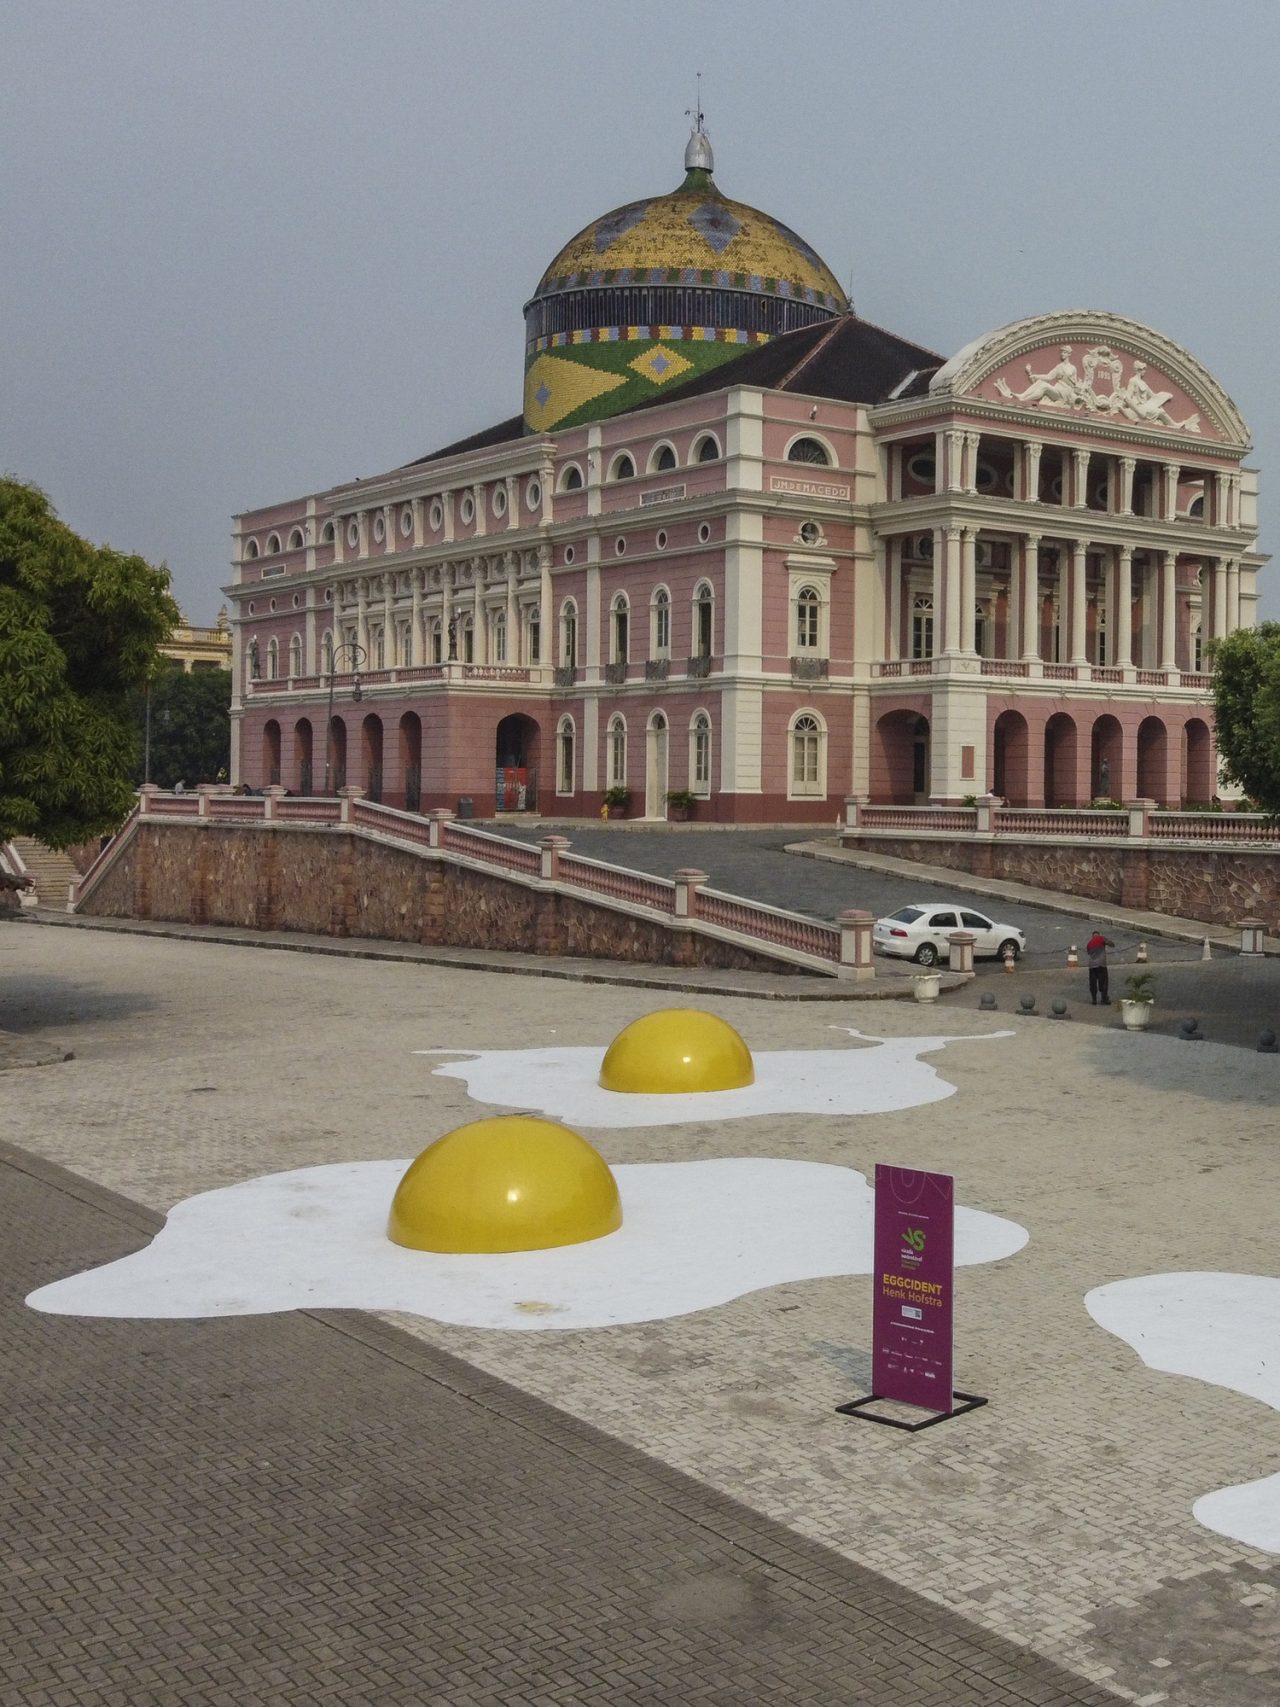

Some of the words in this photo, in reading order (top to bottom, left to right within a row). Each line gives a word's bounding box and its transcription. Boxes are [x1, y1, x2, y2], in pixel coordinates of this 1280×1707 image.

[883, 1273, 942, 1295] EGGCIDENT
[883, 1286, 906, 1300] Henk
[908, 1291, 943, 1307] Hofstra
